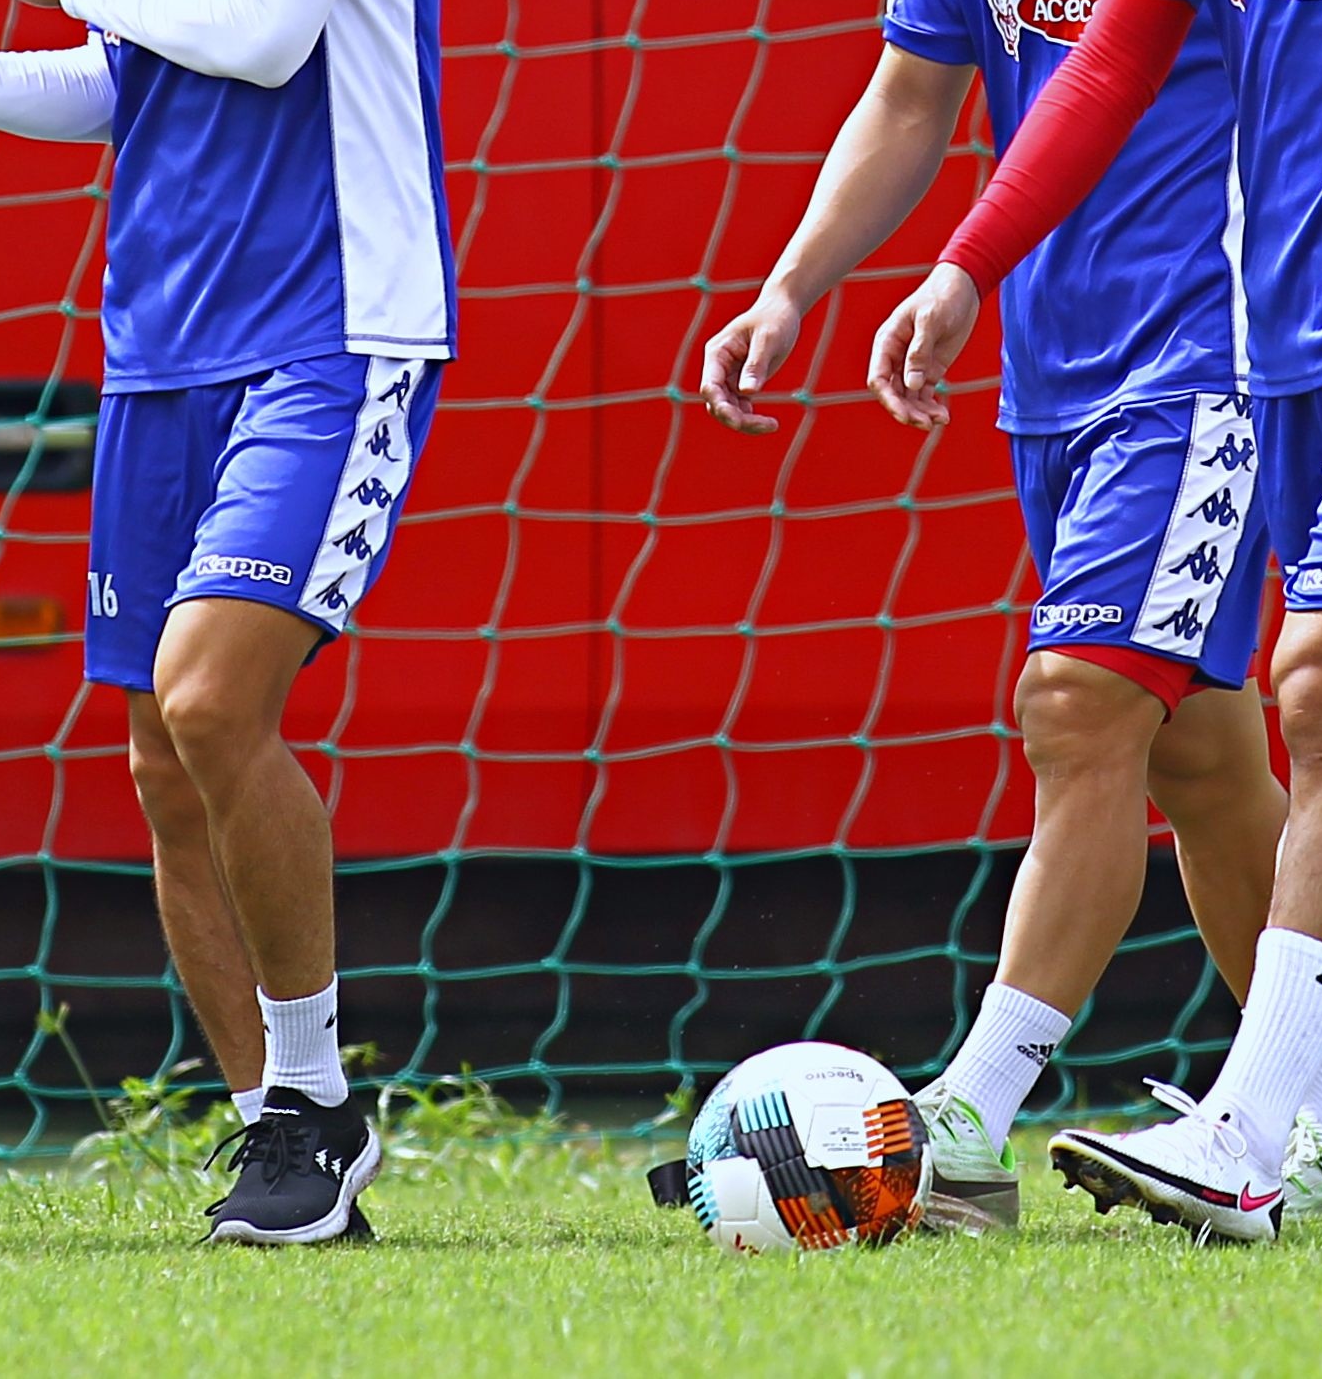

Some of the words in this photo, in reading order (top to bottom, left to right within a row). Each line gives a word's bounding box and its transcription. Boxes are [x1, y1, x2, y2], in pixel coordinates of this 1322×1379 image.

[194, 553, 293, 585] Kappa
[87, 570, 119, 618] 16
[1033, 603, 1123, 628] Kappa
